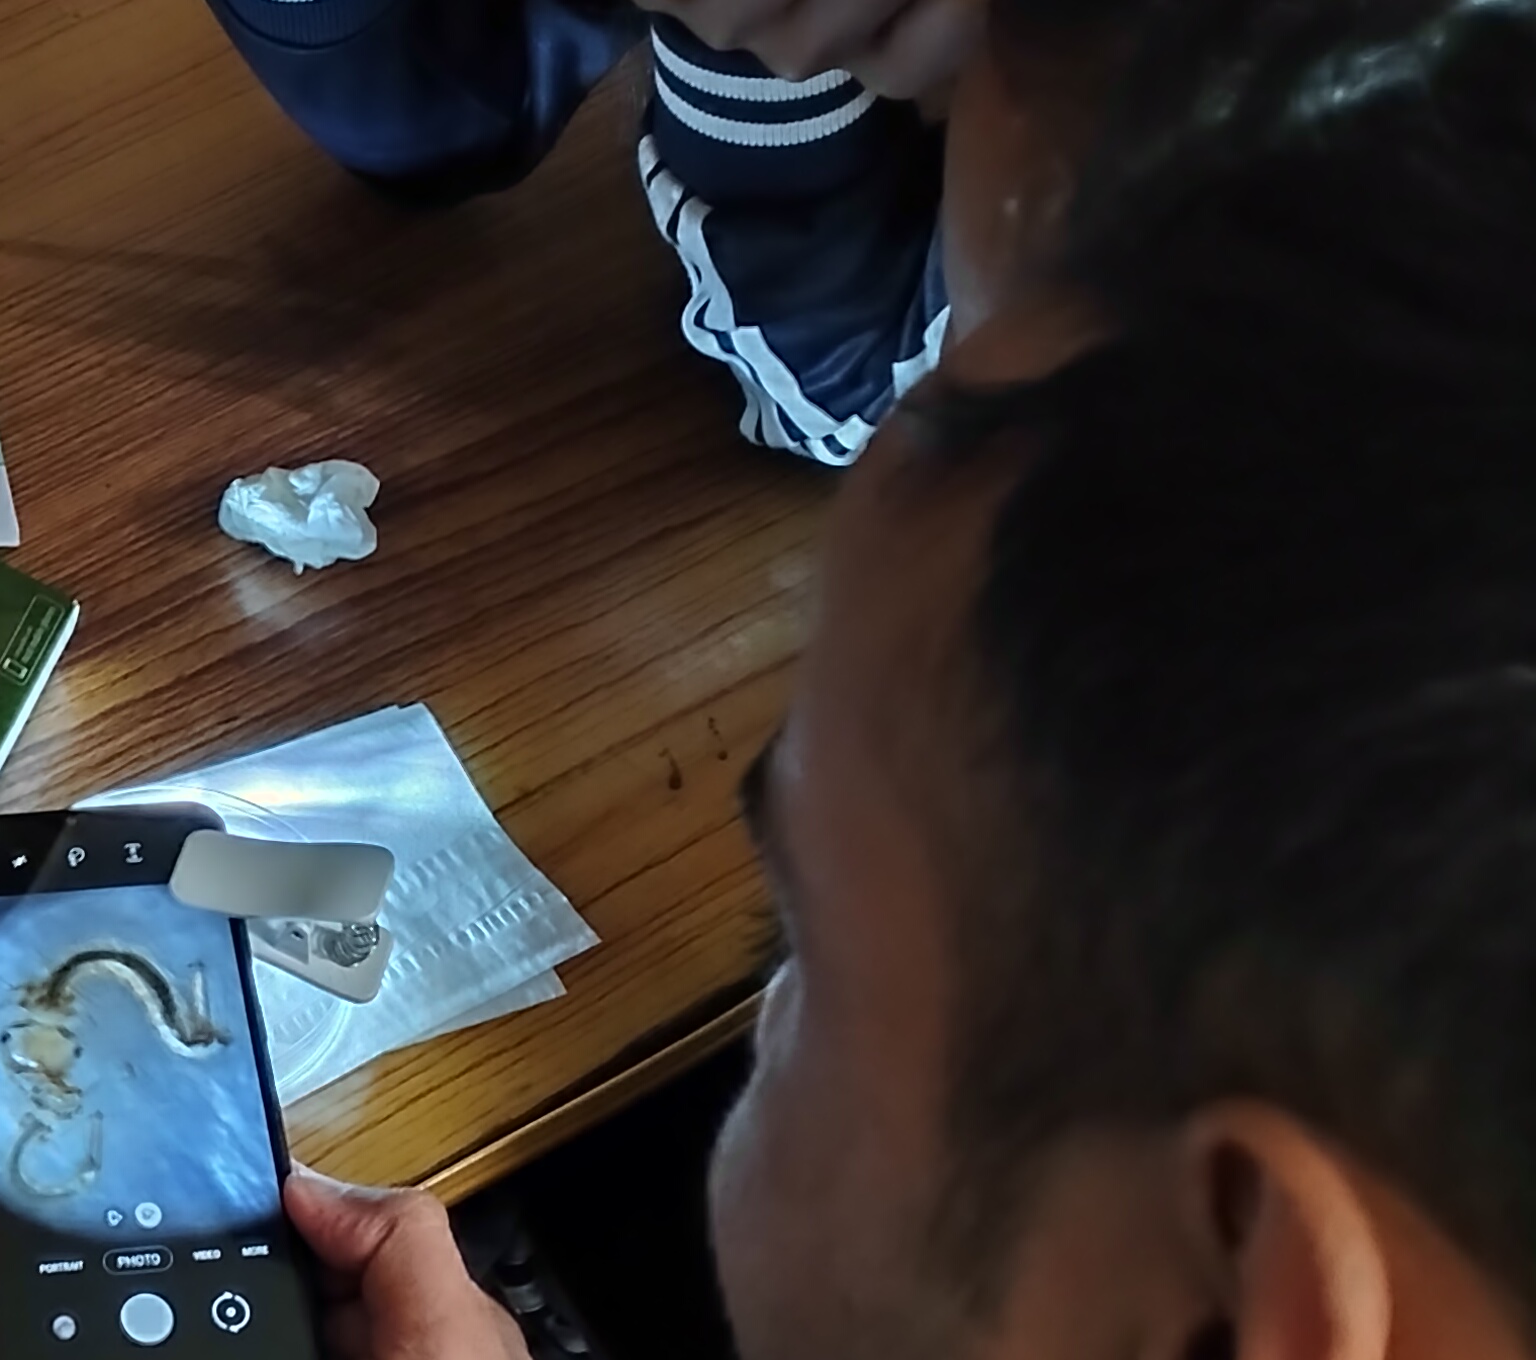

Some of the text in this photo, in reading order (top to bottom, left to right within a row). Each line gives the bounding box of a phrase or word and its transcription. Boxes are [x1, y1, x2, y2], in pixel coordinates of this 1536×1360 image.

[39, 1260, 84, 1275] PORTRAIT
[116, 1253, 161, 1270] PHOTO
[192, 1249, 222, 1261] VIDEO
